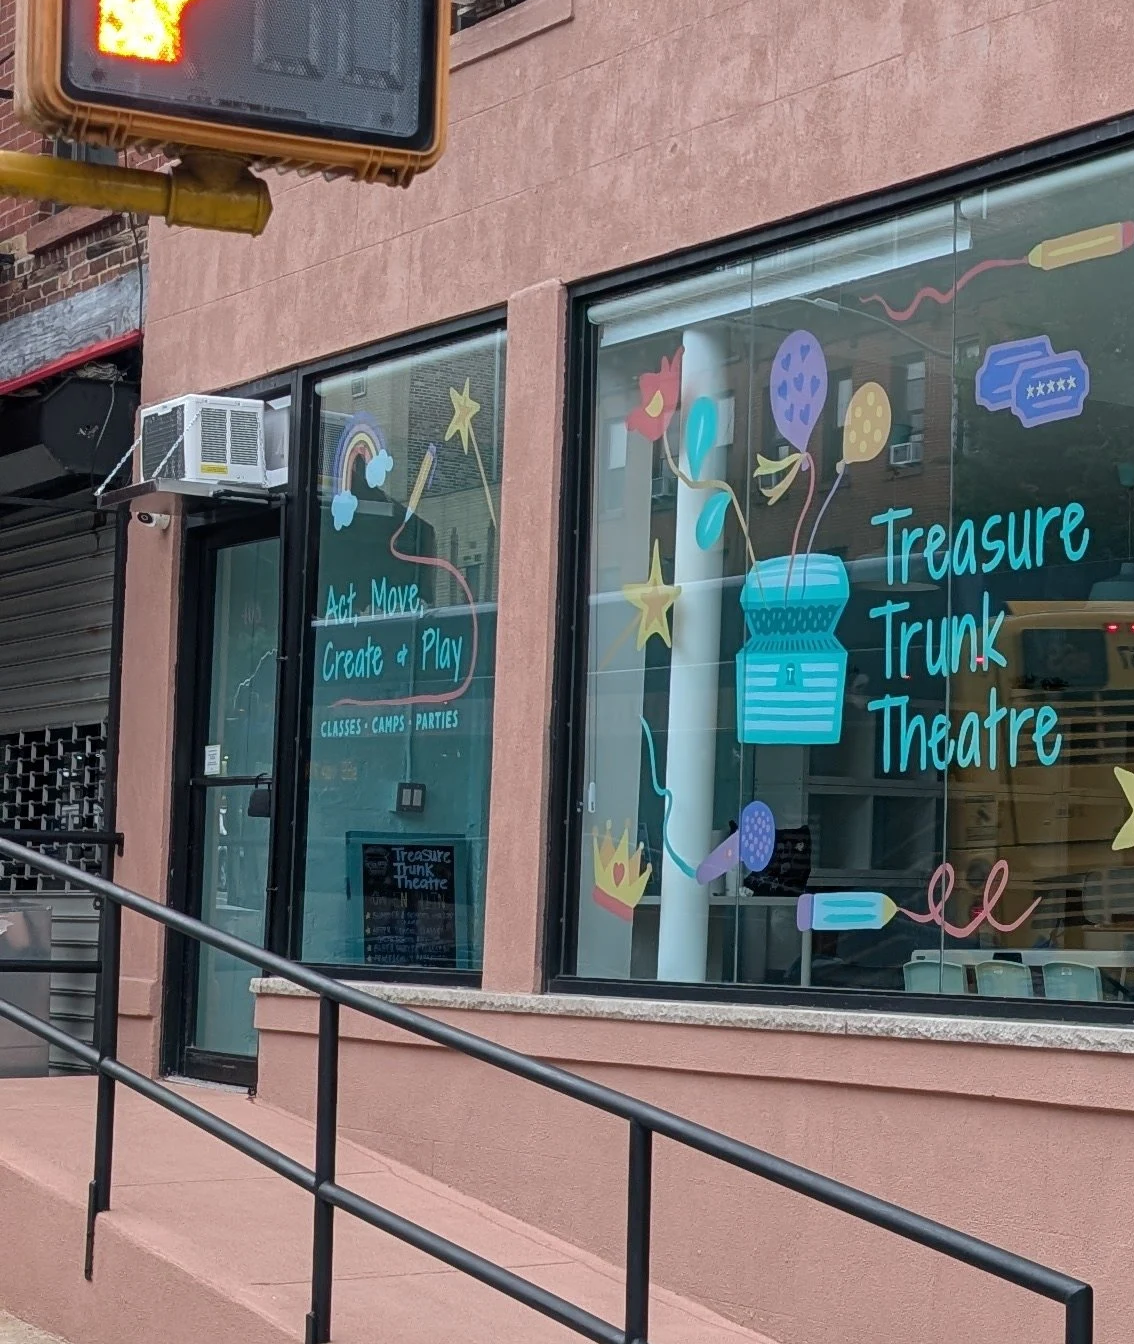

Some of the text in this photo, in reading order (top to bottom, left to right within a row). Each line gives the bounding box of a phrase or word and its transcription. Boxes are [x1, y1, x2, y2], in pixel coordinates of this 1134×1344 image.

[870, 502, 1090, 585] Treasure
[324, 576, 425, 628] Act, Move,
[322, 636, 384, 682] Create
[421, 627, 463, 683] Play
[869, 591, 1008, 679] Trunk
[320, 710, 459, 738] CLASSES CAMPS PARTIES
[867, 686, 1062, 773] Theatre
[391, 846, 452, 864] Treasure
[392, 862, 435, 878] Trunk
[393, 875, 448, 891] Theatre
